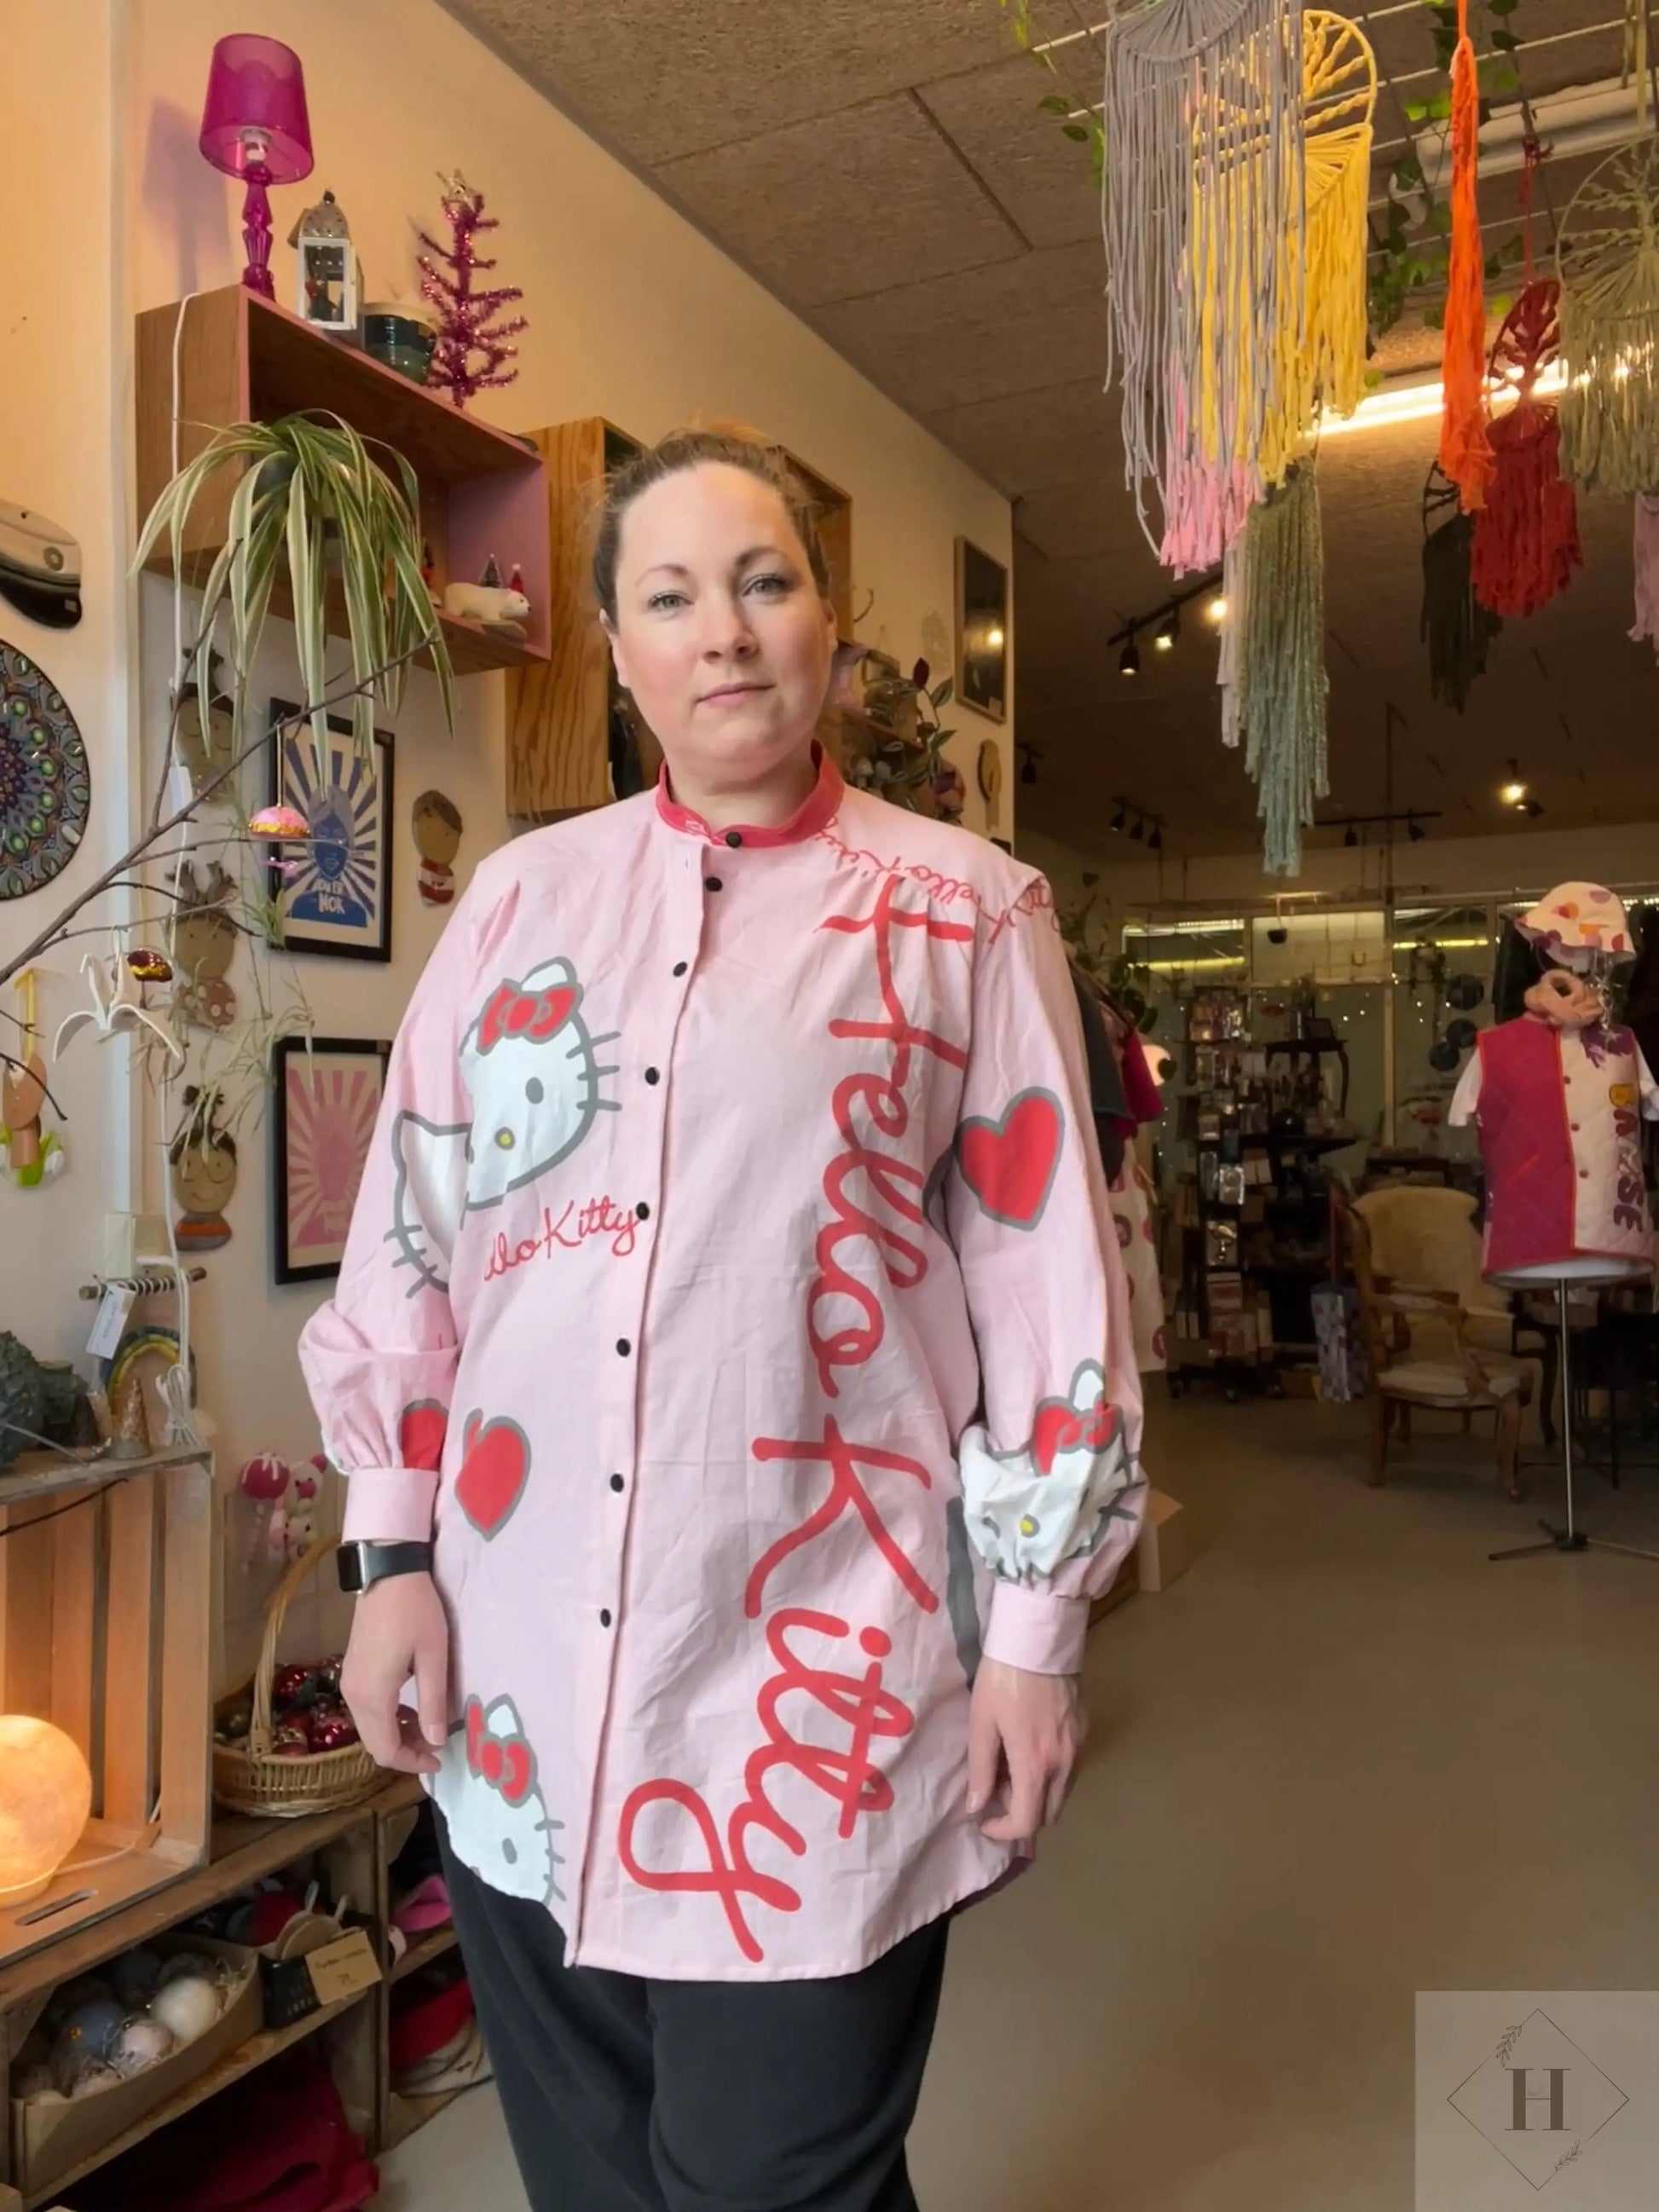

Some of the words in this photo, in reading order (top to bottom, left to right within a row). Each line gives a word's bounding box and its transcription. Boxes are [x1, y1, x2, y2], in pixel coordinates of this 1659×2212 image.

[544, 1194, 641, 1259] Kitty
[806, 874, 974, 1399] Hello
[617, 1413, 940, 1963] Kitty
